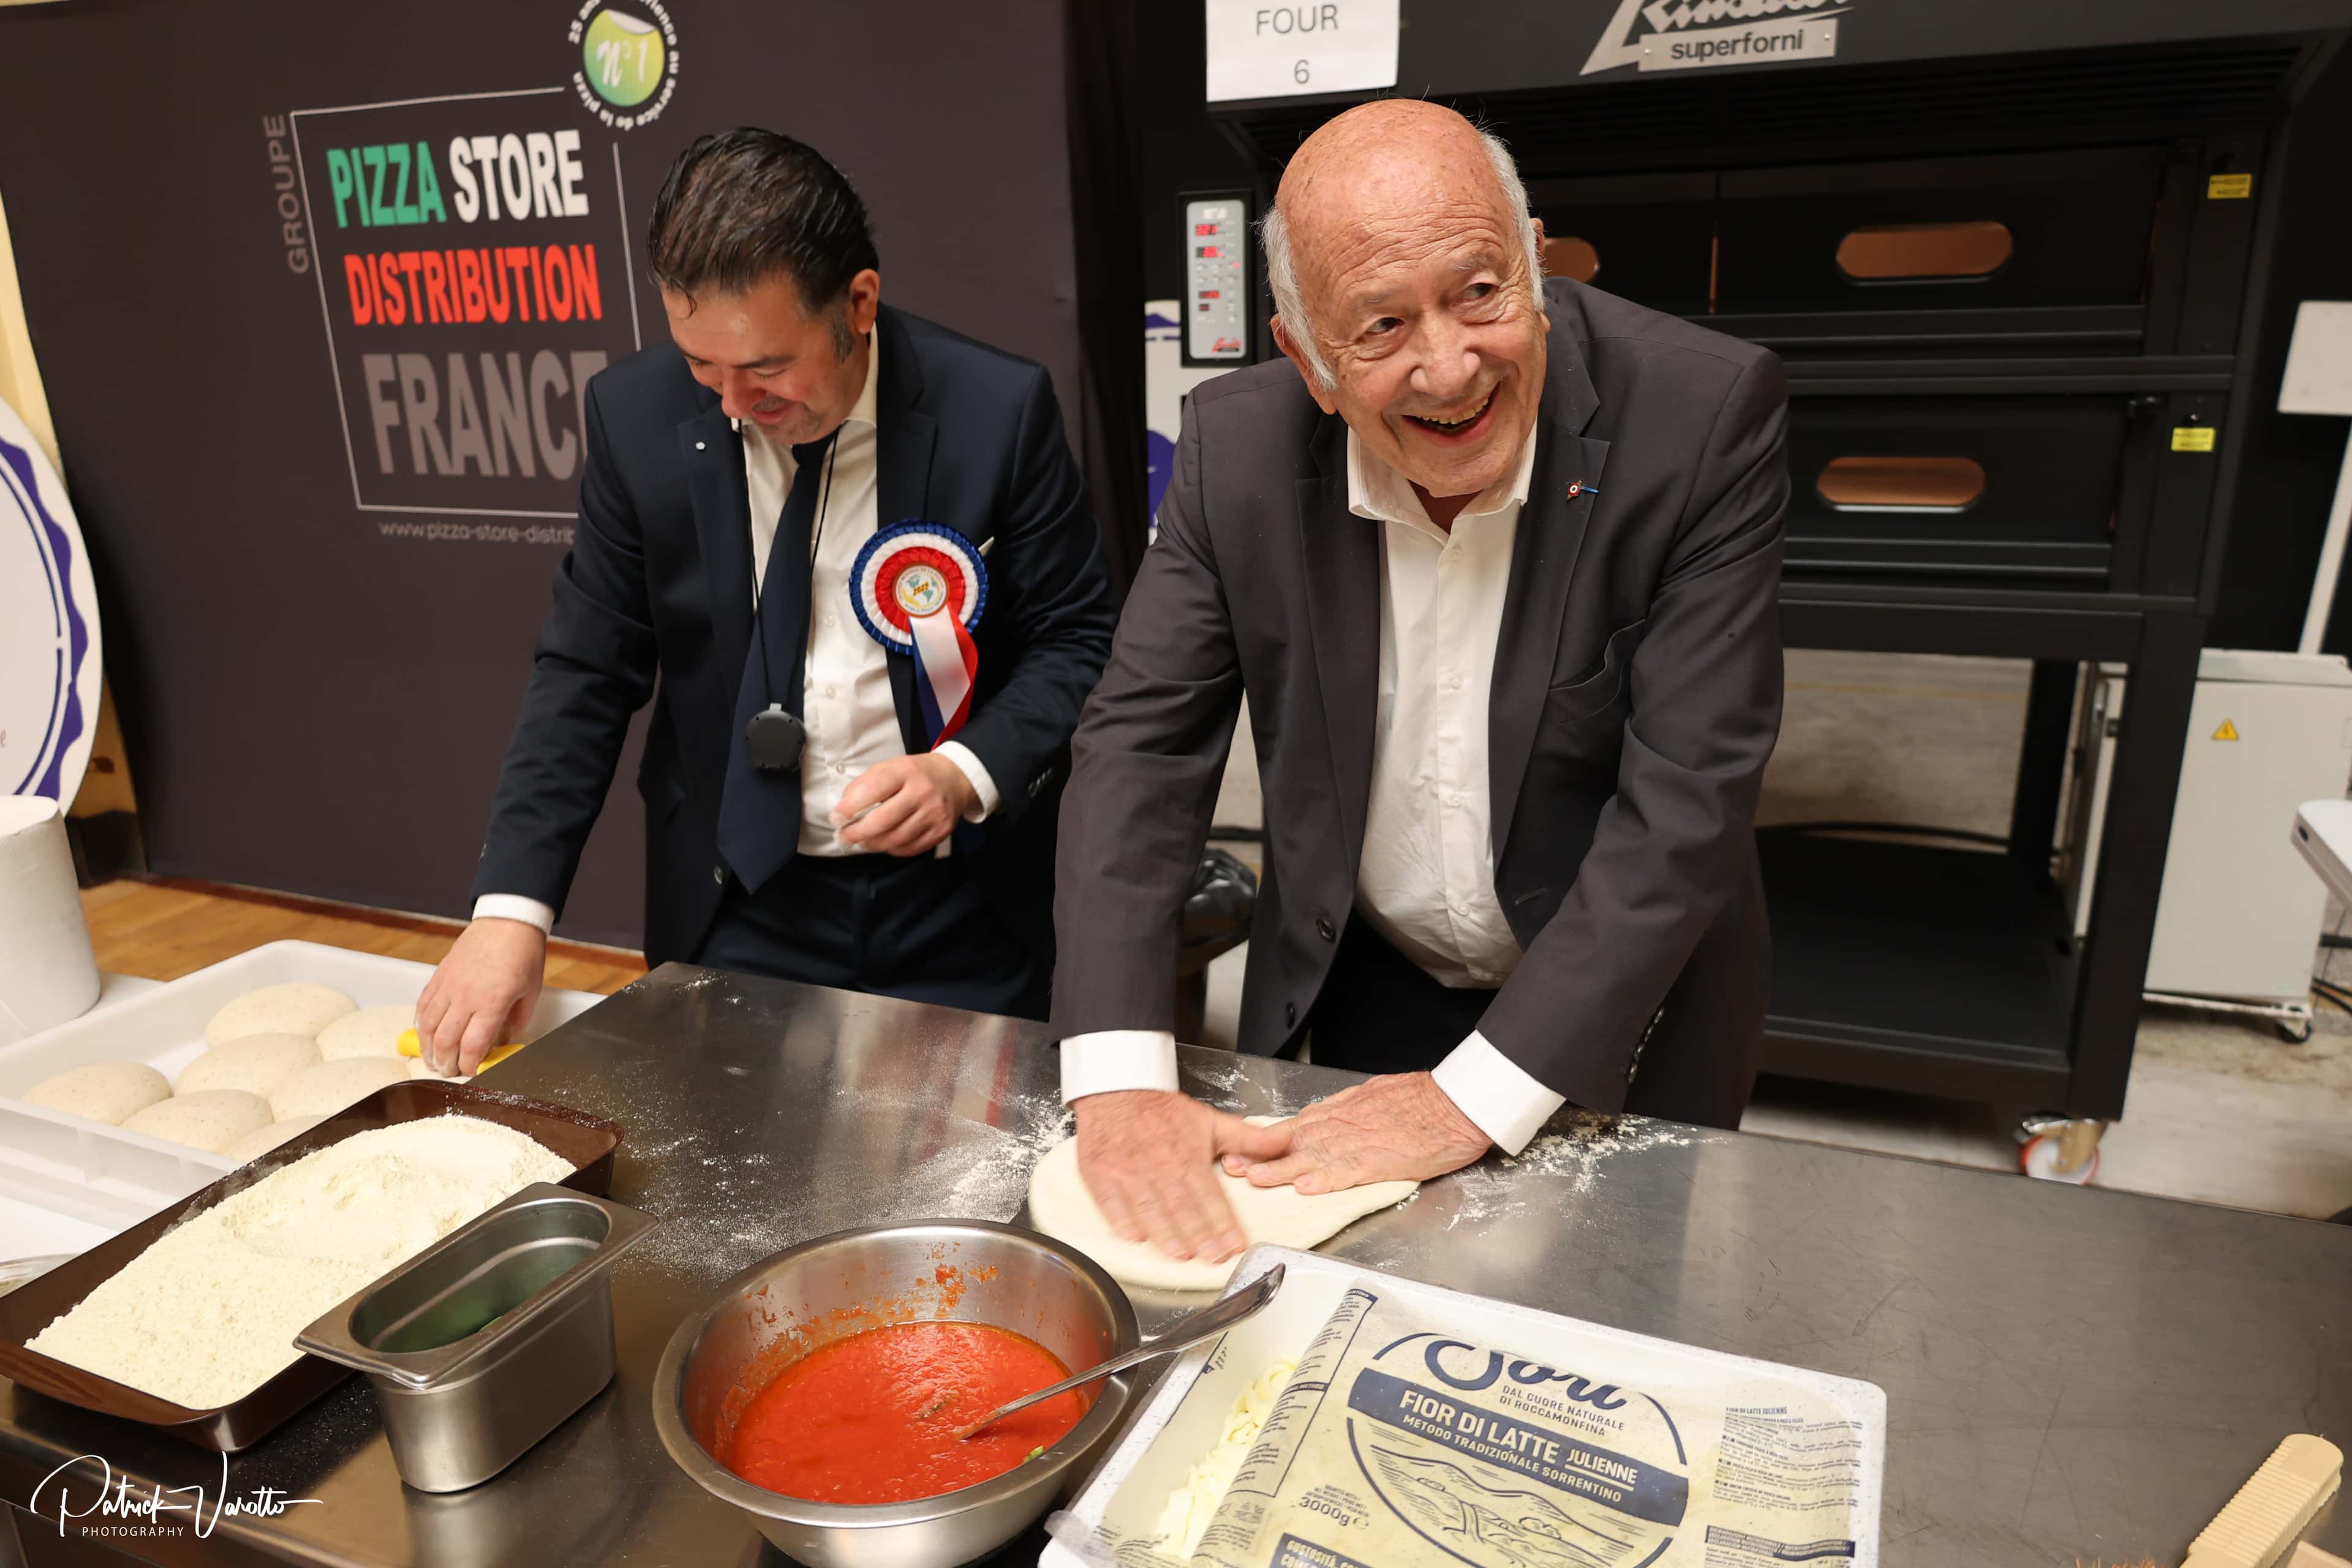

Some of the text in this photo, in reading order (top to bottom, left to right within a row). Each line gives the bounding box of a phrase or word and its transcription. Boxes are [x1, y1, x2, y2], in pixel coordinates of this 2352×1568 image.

[1256, 4, 1339, 36] FOUR
[1670, 29, 1804, 62] superforni
[573, 71, 601, 113] pizza
[1294, 59, 1310, 85] 6
[264, 114, 309, 274] GROUPE
[326, 130, 589, 228] PIZZA STORE
[344, 243, 603, 326] DISTRIBUTION
[1499, 1395, 1605, 1436] DI ROCCAMONFINA
[1502, 1385, 1626, 1431] DAL CUORE NATURALE
[1399, 1390, 1638, 1485] FIOR DI LATTE JULIENNE
[1403, 1415, 1623, 1502] METODO TRADIZIONALE SORRENTINO
[1299, 1496, 1350, 1526] 3000g
